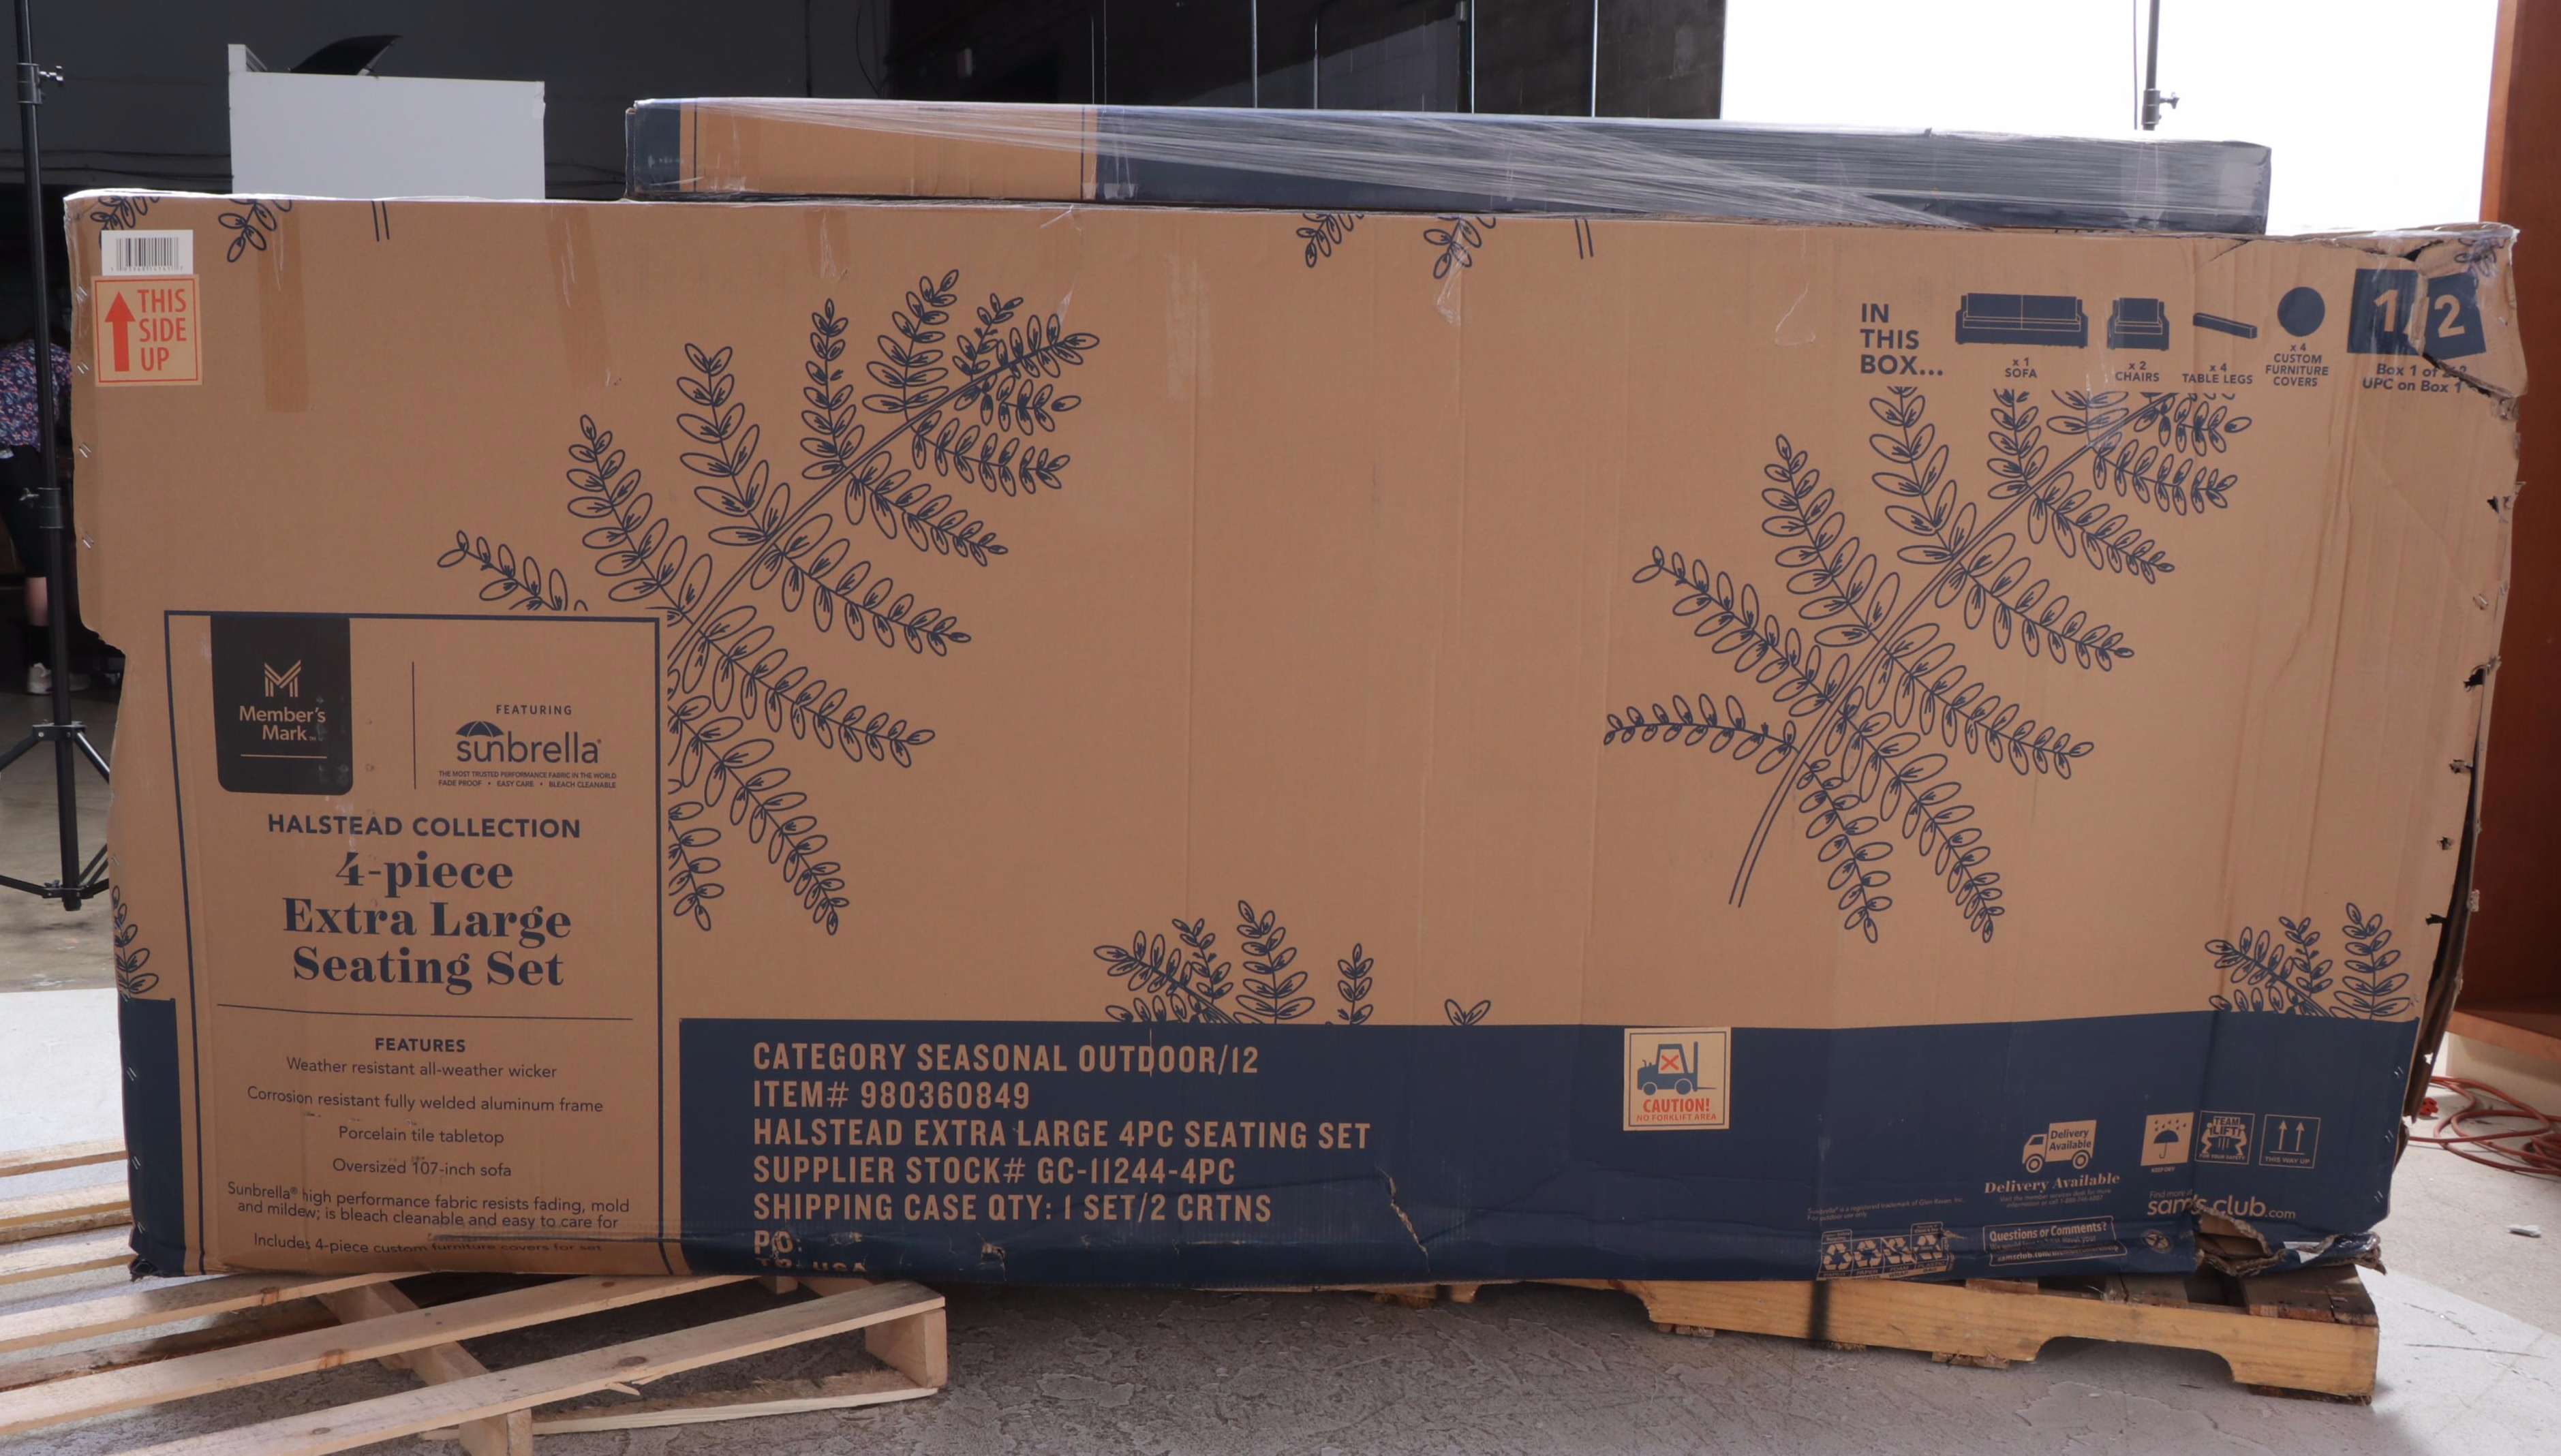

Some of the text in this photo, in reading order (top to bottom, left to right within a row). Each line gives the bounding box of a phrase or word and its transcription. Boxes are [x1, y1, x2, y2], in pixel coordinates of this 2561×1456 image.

[137, 289, 186, 313] THIS
[1862, 303, 1888, 323] IN
[139, 317, 186, 342] SIDE
[1860, 329, 1918, 350] THIS
[2300, 343, 2306, 352] 4
[141, 347, 169, 371] UP
[1861, 354, 1942, 375] BOX...
[2024, 358, 2029, 366] 1
[2140, 361, 2146, 370] 2
[2220, 363, 2227, 372] 4
[2274, 354, 2322, 364] CUSTOM
[2005, 368, 2037, 378] SOFA
[2115, 372, 2159, 382] CHAIRS
[2182, 373, 2252, 384] TABLE LEGS
[2266, 365, 2329, 375] FURNITURE
[2376, 363, 2404, 375] Box
[2410, 365, 2417, 376] 1
[2273, 377, 2317, 386] COVERS
[2363, 377, 2464, 393] UPC on Box 1
[497, 704, 571, 715] FEATURING
[269, 814, 579, 838] HALSTEAD COLLECTION
[336, 851, 512, 898] 4-piece
[282, 898, 570, 948] Extra Large
[294, 946, 564, 995] Seating Set
[375, 1038, 465, 1052] FEATURES
[287, 1057, 557, 1077] Weather resistant all-weather wicker
[754, 1042, 1258, 1074] CATEGORY SEASONAL OUTDOOR/12
[247, 1086, 602, 1112] Corrosion resistant fully welded aluminum frame
[754, 1081, 1028, 1109] ITEM# 980360849
[1643, 1098, 1709, 1113] CAUTION!
[339, 1126, 504, 1147] Porcelain tile tabletop
[754, 1119, 1370, 1149] HALSTEAD EXTRA LARGE 4PC SEATING SET
[2051, 1130, 2089, 1139] Delivery
[2049, 1140, 2091, 1151] Available
[333, 1158, 511, 1176] Oversized 107-inch sofa
[754, 1156, 1234, 1184] SUPPLIER STOCK# GC-11244-4PC
[1985, 1173, 2119, 1193] Delivery Available
[303, 1188, 331, 1206] high
[337, 1192, 429, 1207] performance
[435, 1194, 477, 1209] fabric
[483, 1197, 529, 1209] resists
[534, 1196, 585, 1215] fading,
[592, 1198, 628, 1212] mold
[754, 1193, 891, 1222] SHIPPING
[905, 1194, 976, 1220] CASE
[989, 1194, 1050, 1220] QTY:
[1084, 1193, 1165, 1222] SET/2
[1178, 1194, 1270, 1222] CRTNS
[239, 1201, 618, 1230] and mildew; is bleach cleanable and easy to care for
[1989, 1222, 2106, 1242] Questions or Comments?
[255, 1233, 311, 1250] Includes
[316, 1239, 369, 1254] 4-piece
[371, 1245, 429, 1256] custom
[431, 1242, 496, 1252] furniture
[553, 1243, 576, 1252] for
[580, 1243, 602, 1252] set
